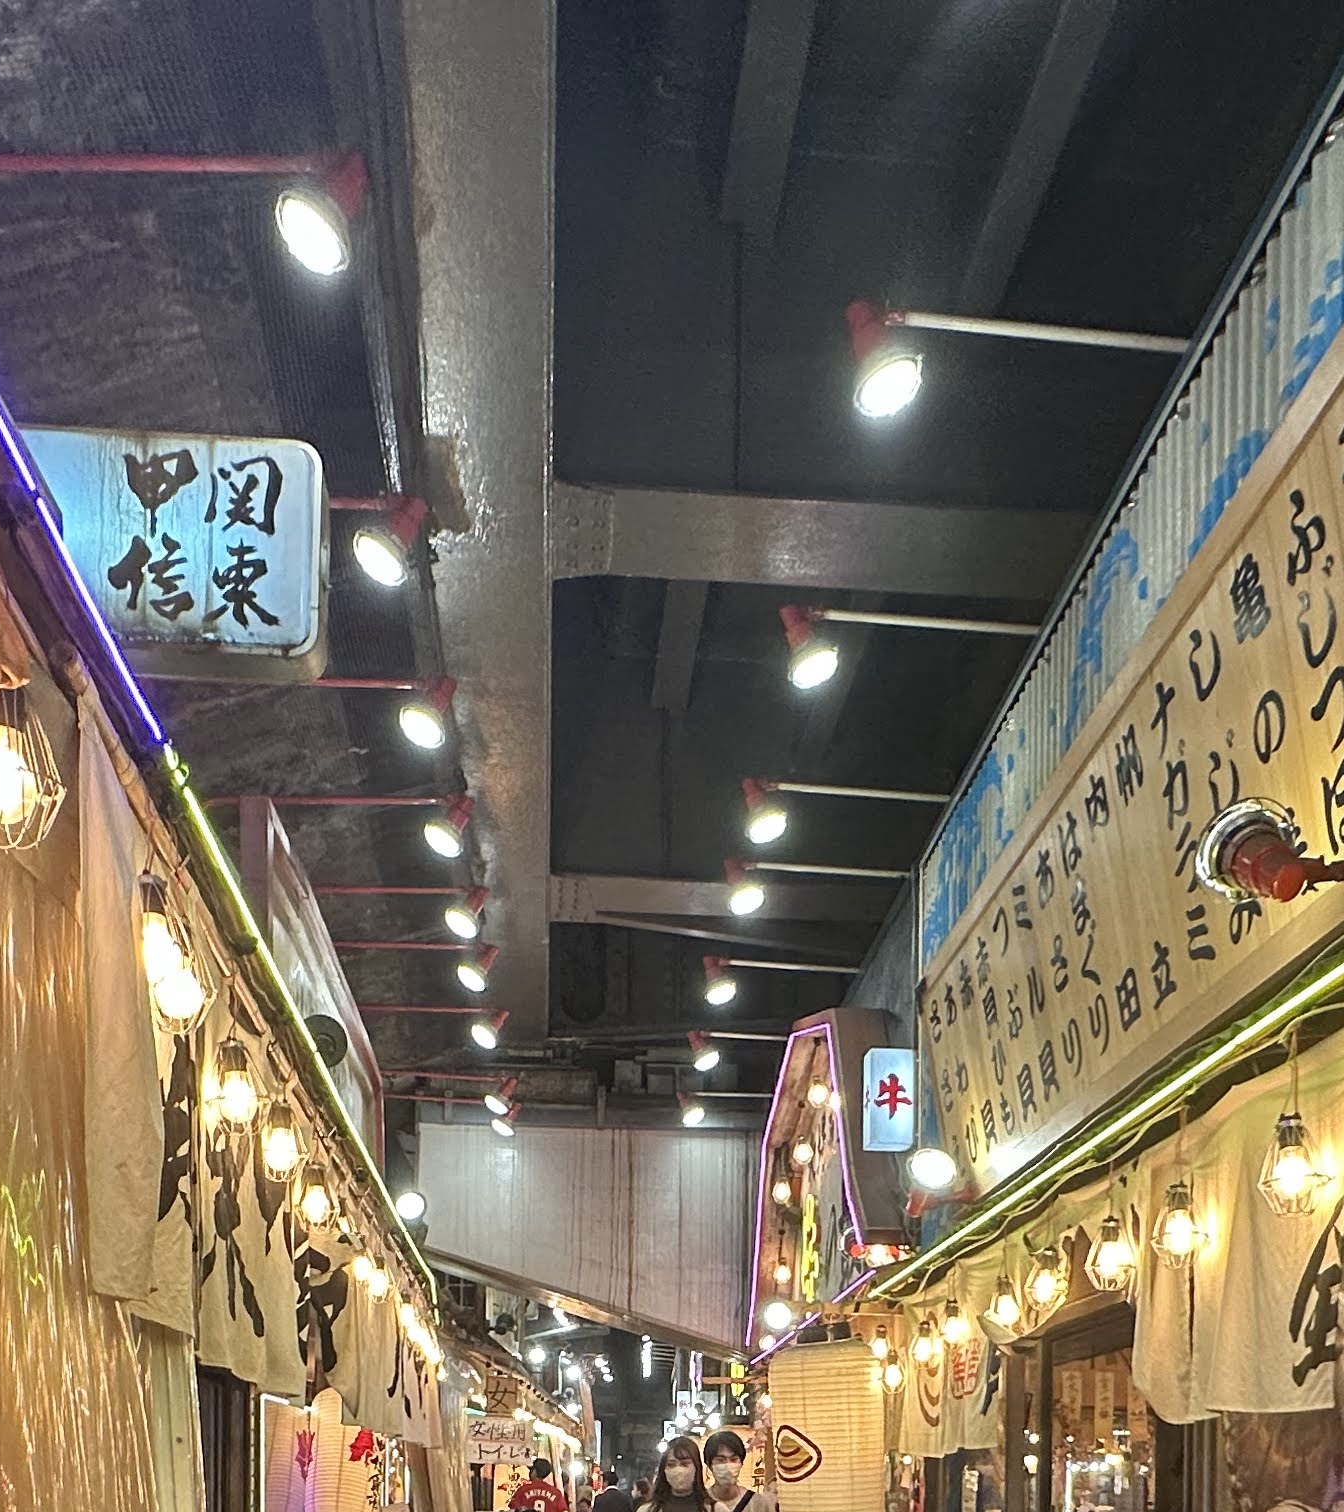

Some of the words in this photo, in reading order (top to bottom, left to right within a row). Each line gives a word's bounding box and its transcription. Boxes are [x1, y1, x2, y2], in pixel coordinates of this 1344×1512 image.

[108, 449, 198, 622] 甲信
[204, 456, 283, 628] 関東
[993, 906, 1038, 1123] つぶ貝
[1012, 884, 1060, 1102] ミル貝
[1035, 849, 1083, 1078] あさり
[1057, 811, 1110, 1056] はまぐり
[873, 1073, 913, 1120] 牛
[486, 1379, 516, 1410] 女
